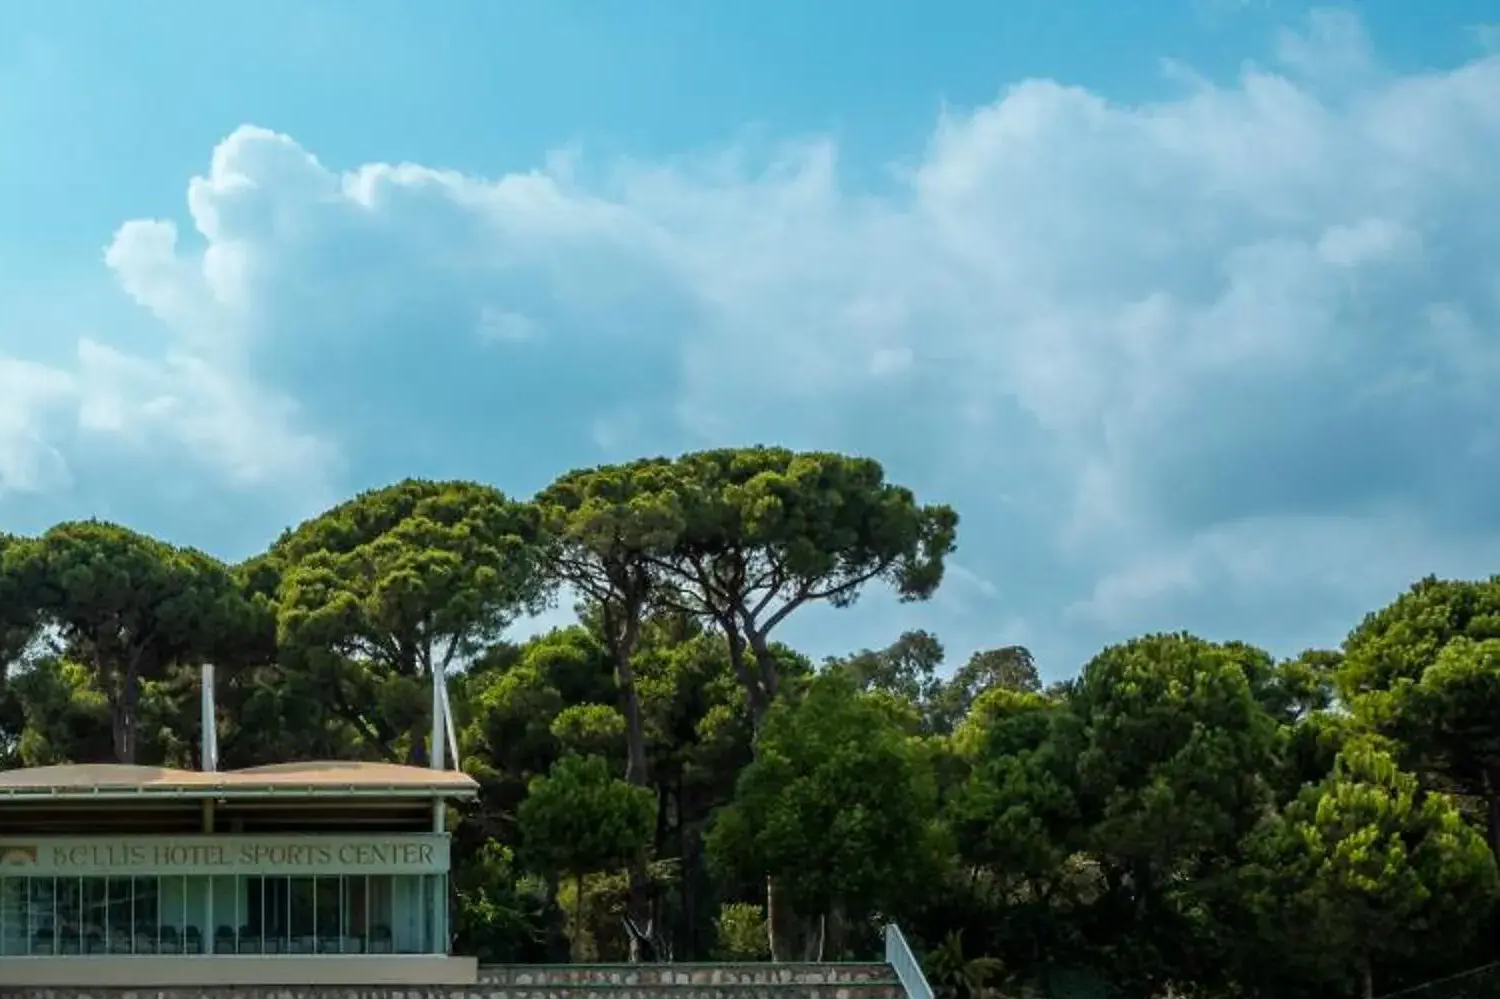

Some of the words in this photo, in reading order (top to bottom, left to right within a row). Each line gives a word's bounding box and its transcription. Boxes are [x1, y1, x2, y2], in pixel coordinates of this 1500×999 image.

[154, 844, 232, 866] HOTEL
[239, 843, 331, 865] SPORTS
[339, 842, 434, 865] CENTER
